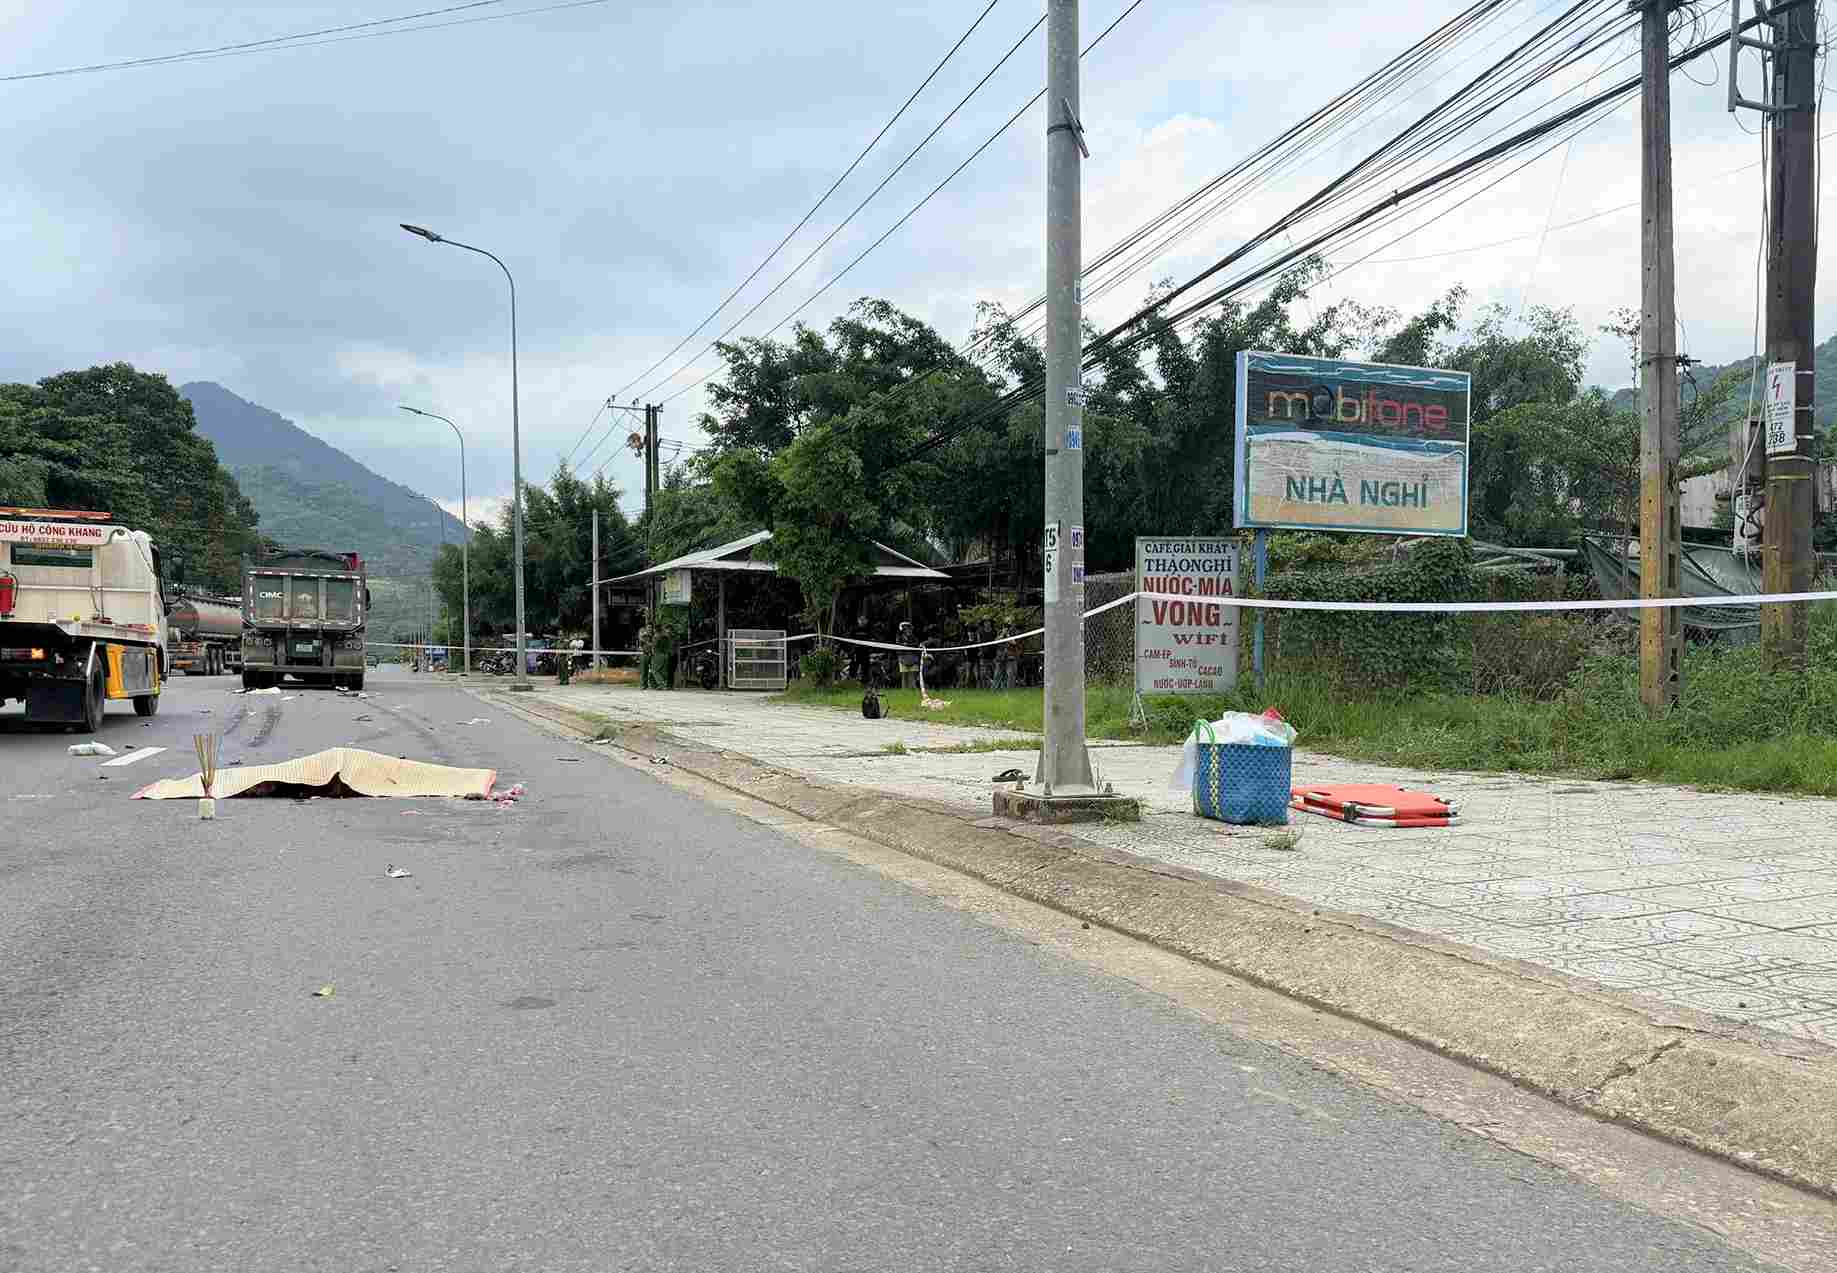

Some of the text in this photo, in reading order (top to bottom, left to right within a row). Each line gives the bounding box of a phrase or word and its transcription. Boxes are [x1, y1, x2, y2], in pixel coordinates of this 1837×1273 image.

[1285, 471, 1428, 508] NHÀ NGHỈ
[69, 527, 102, 537] KHANG
